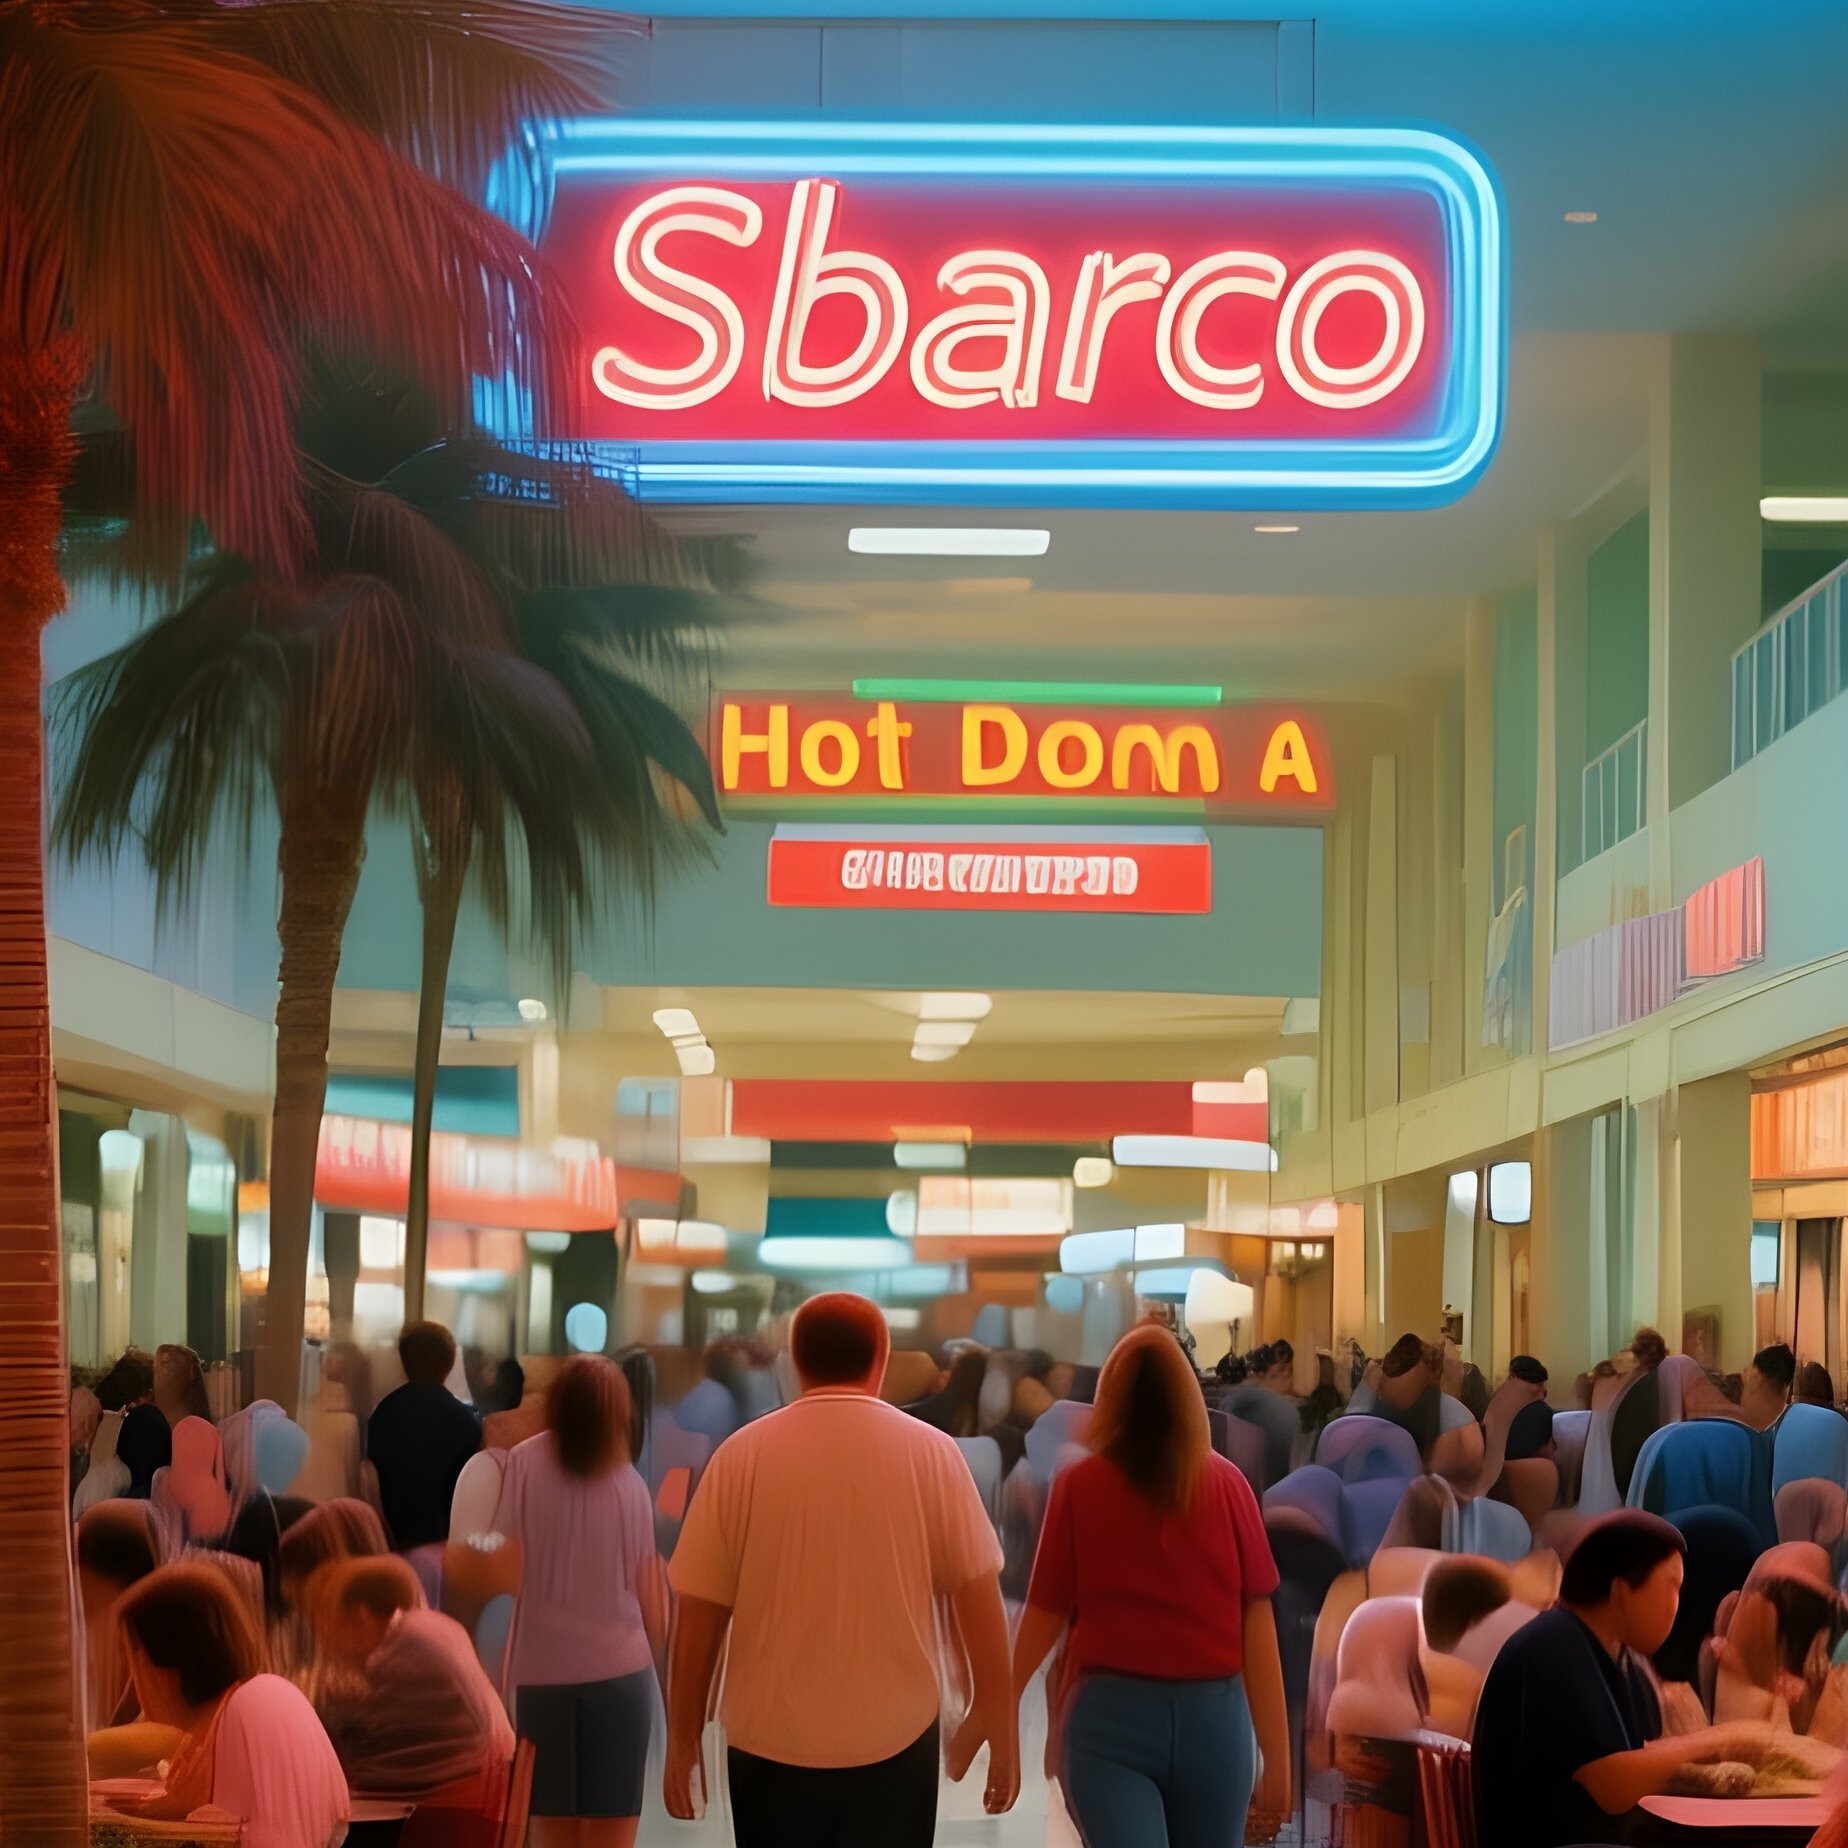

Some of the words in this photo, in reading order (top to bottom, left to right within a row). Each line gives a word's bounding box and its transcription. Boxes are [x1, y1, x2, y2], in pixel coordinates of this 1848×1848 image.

[592, 178, 1426, 410] Sbarco
[721, 702, 913, 791] Hot
[961, 704, 1220, 793] Dom
[1259, 720, 1318, 793] A
